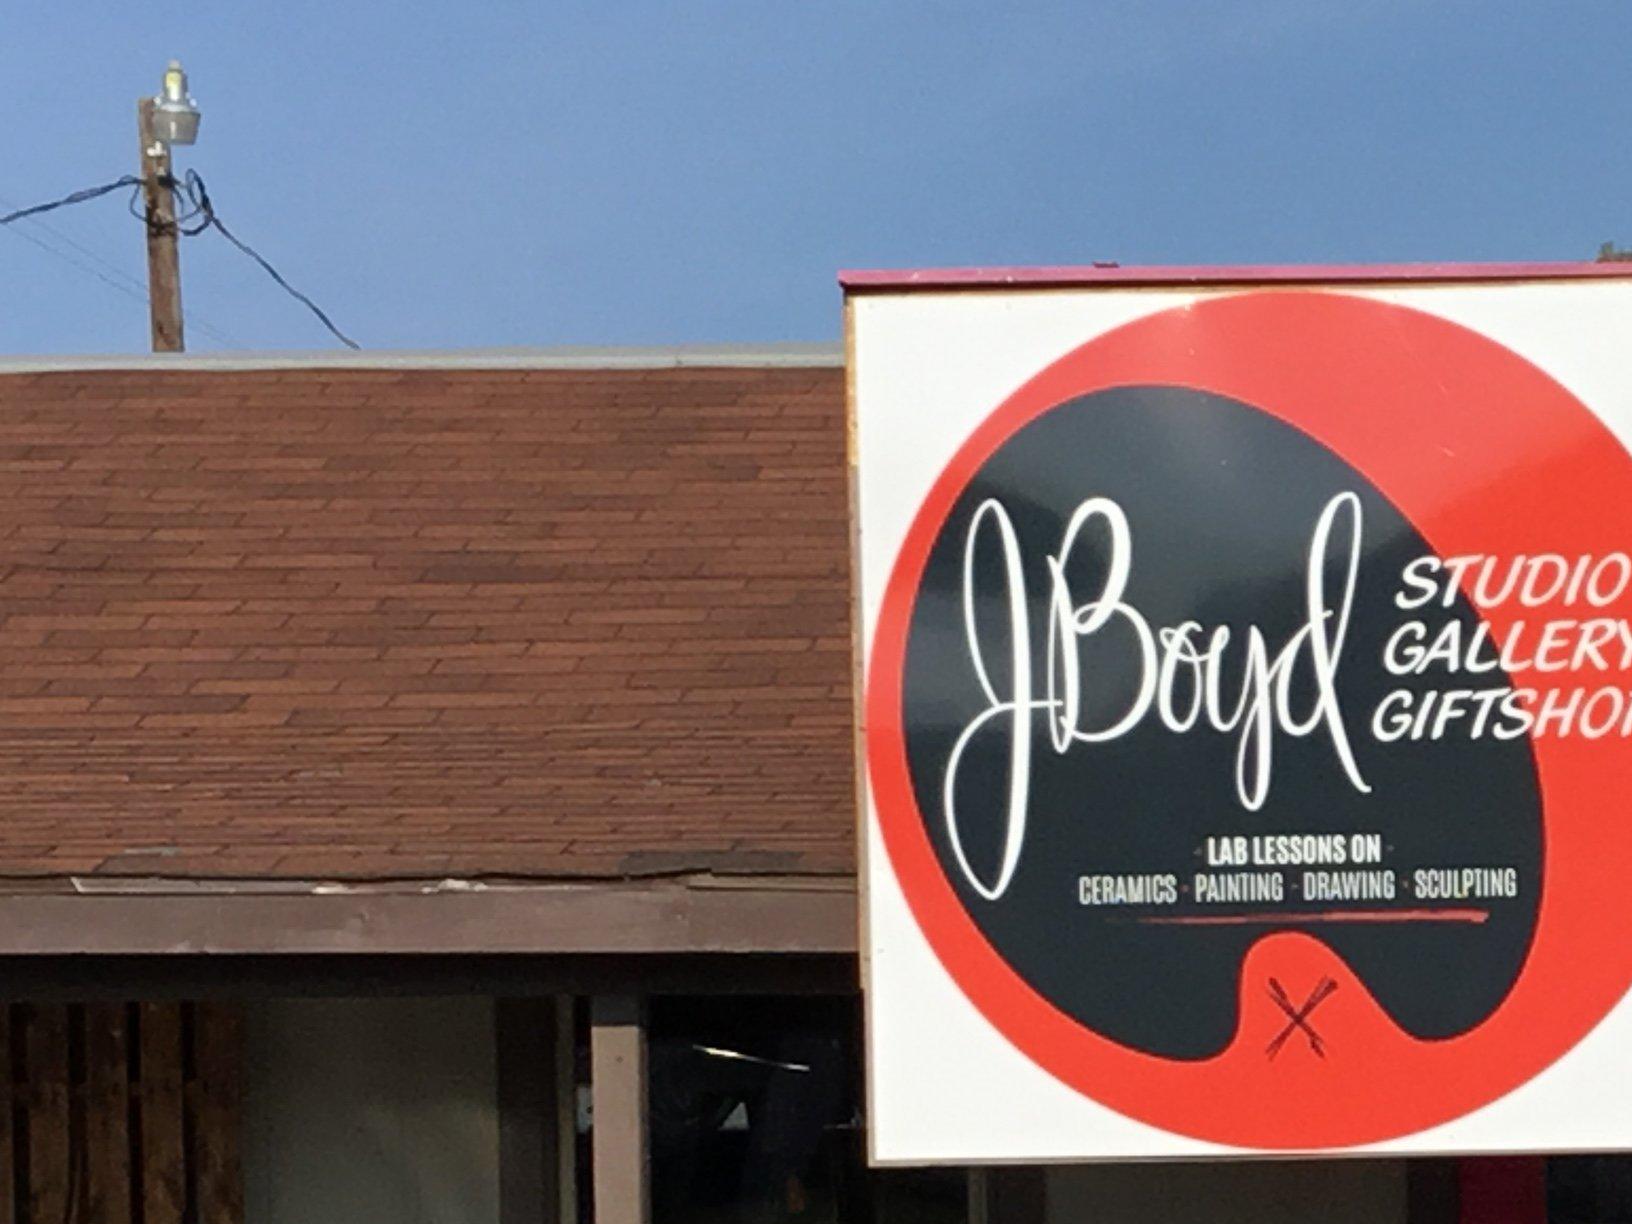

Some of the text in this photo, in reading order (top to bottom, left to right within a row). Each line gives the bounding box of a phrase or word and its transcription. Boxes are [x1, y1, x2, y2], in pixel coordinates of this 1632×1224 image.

[1396, 552, 1632, 609] STUDIO
[1208, 834, 1381, 866] LAB LESSONS ON
[1079, 867, 1516, 905] CERAMICS PAINTING DRAWING SCULPTING
